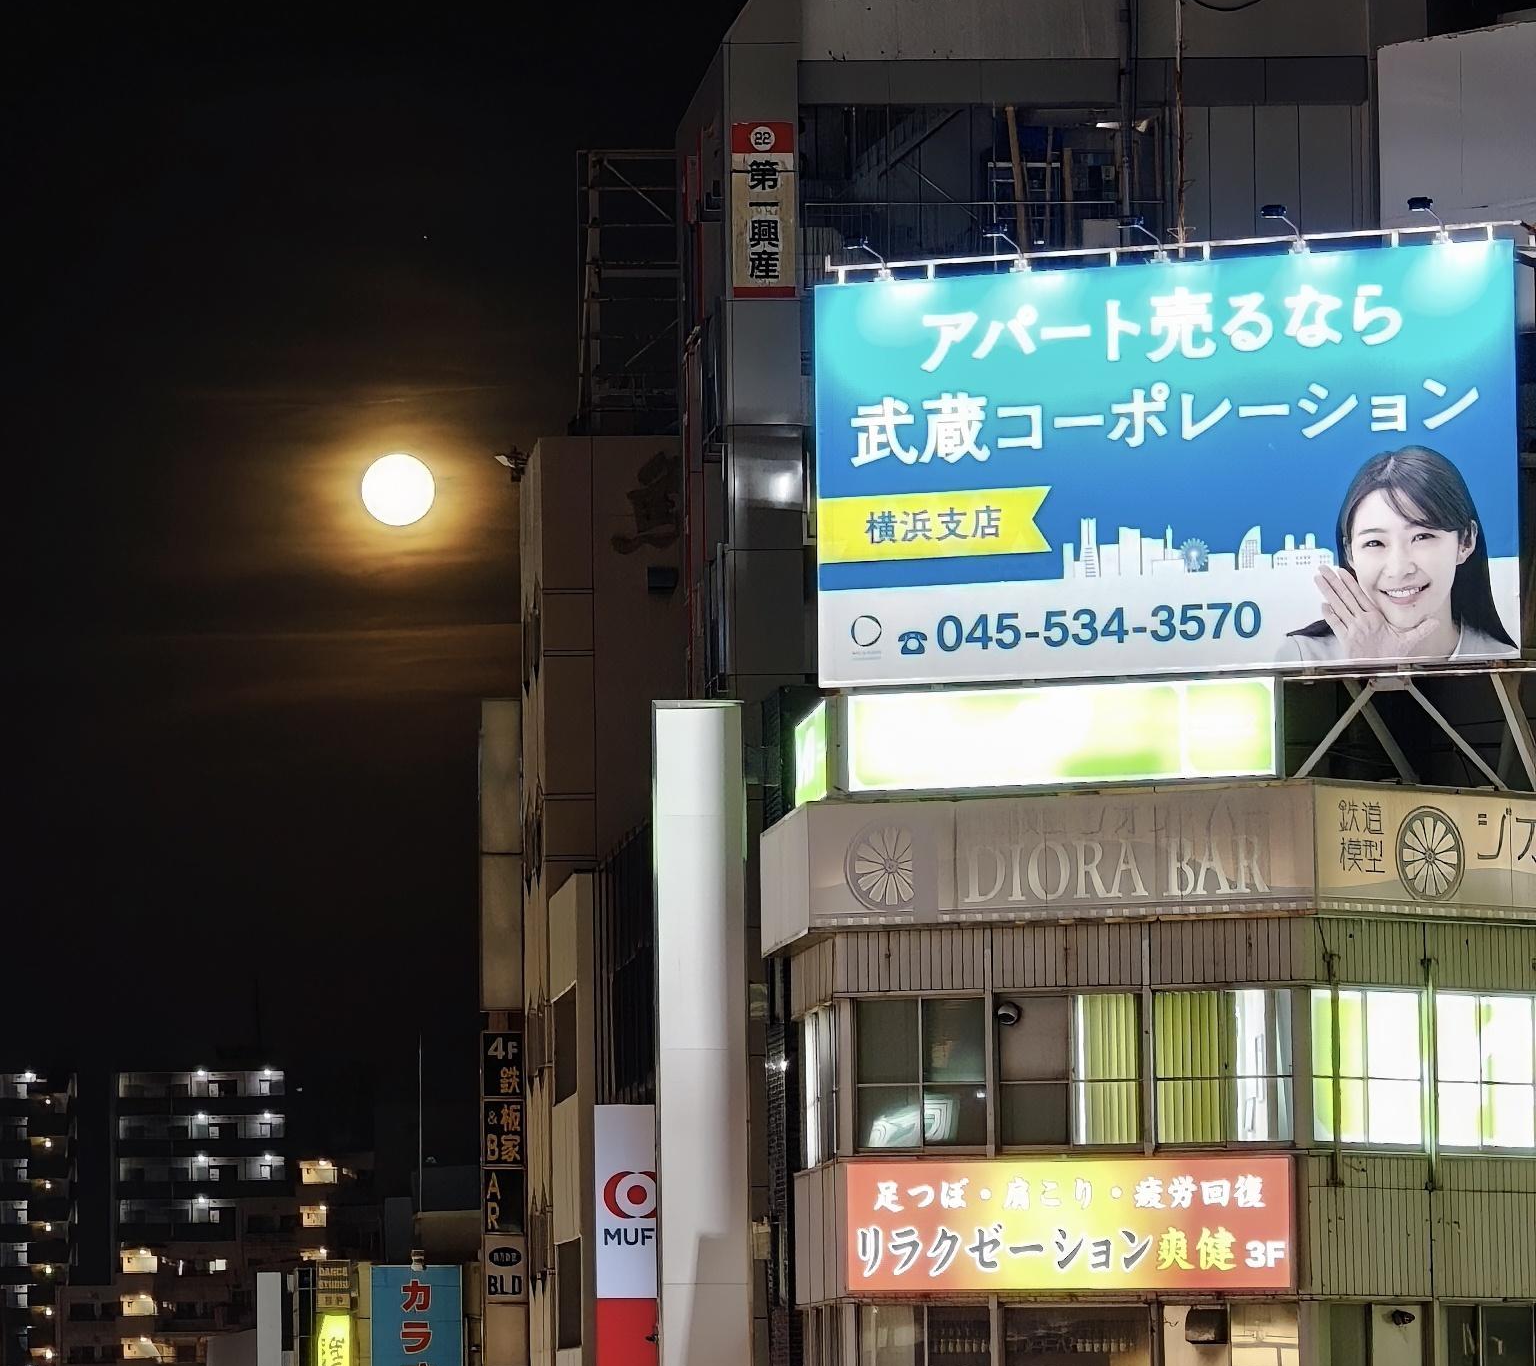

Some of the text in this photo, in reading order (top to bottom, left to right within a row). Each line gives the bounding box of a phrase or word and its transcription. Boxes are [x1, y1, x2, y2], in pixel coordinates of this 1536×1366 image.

[748, 160, 780, 280] 第一興産
[920, 283, 1404, 373] アパート売るなら
[850, 379, 1480, 469] 武蔵コーポレーション
[863, 504, 1002, 546] 横浜支店
[936, 600, 1263, 654] 045-534-3570
[1338, 798, 1385, 835] 鉄道
[964, 834, 1272, 903] DIORA BAR
[1339, 837, 1386, 874] 模型
[488, 1036, 518, 1060] 4F
[872, 1175, 1267, 1212] 足つぼ・肩こり・疲労回復
[1245, 1240, 1286, 1270] 3F
[487, 1274, 522, 1295] BLD
